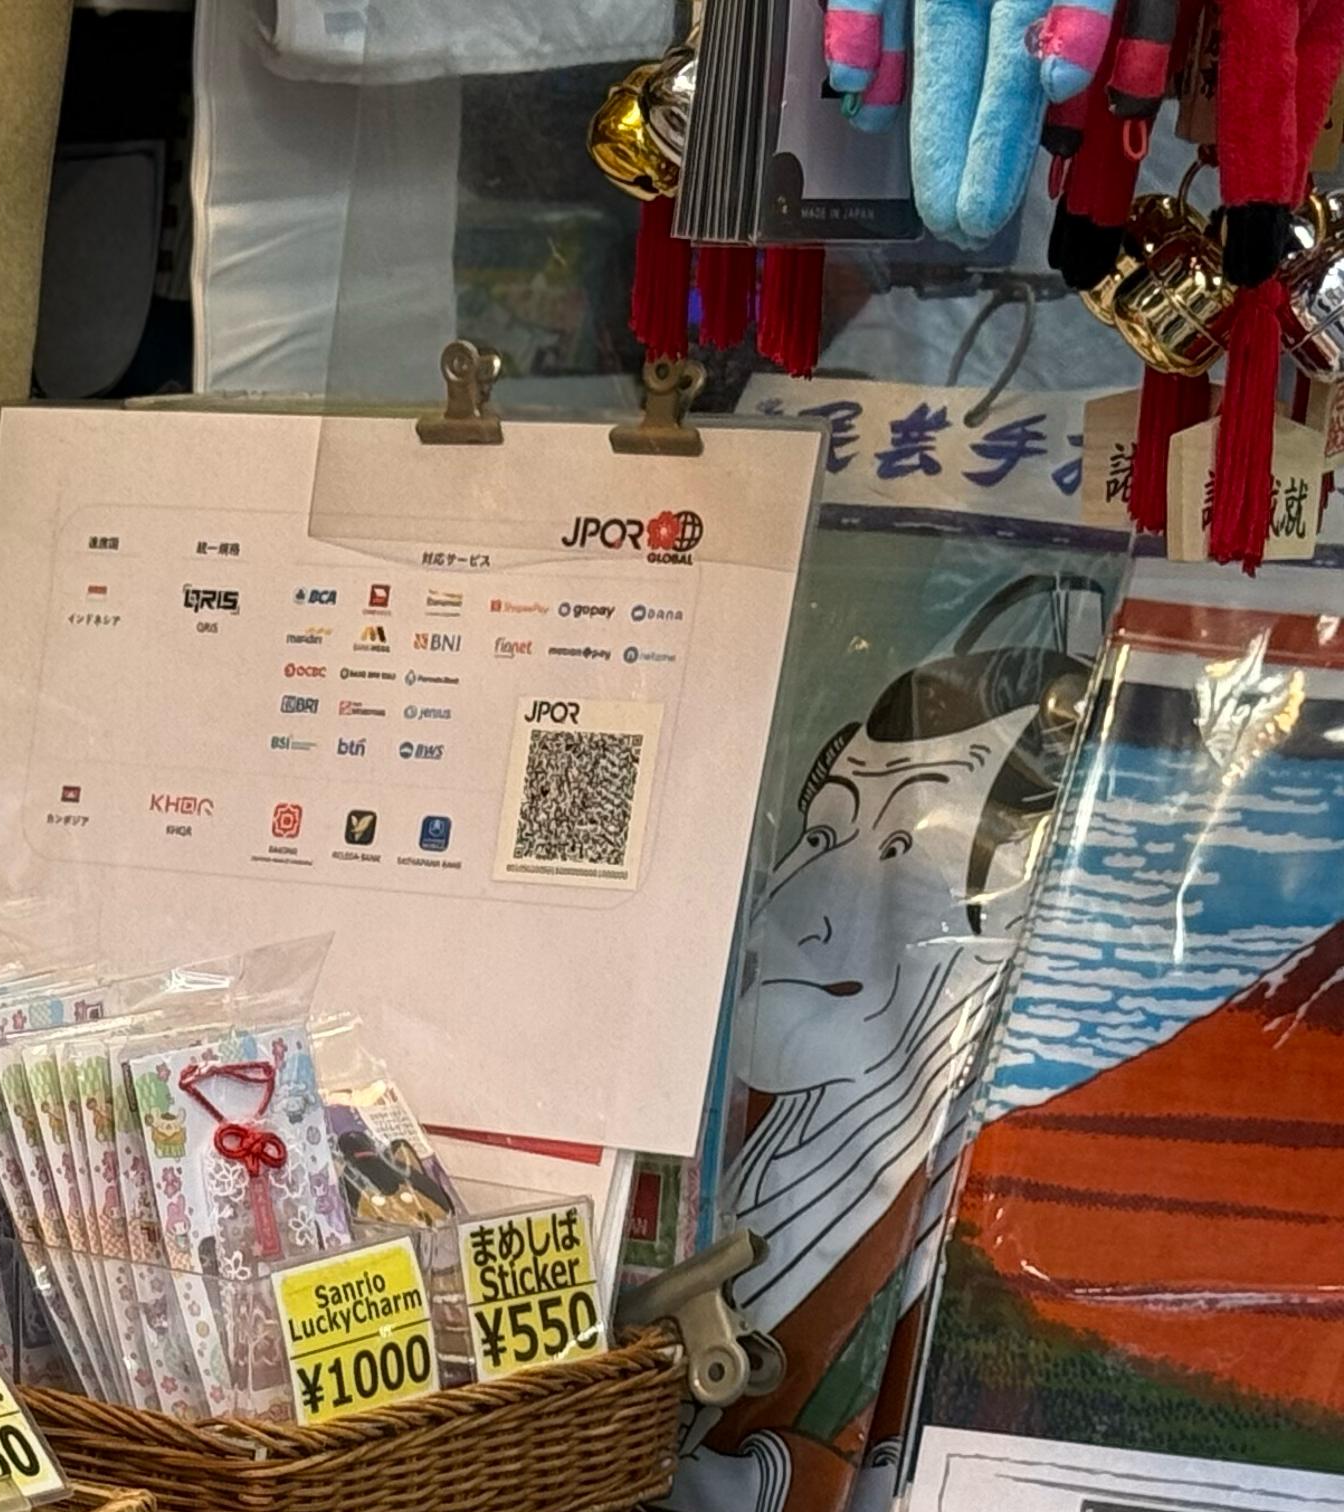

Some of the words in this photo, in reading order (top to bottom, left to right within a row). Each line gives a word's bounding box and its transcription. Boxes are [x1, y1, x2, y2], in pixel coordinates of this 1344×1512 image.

[801, 206, 829, 220] MADE
[831, 207, 842, 220] IN
[843, 207, 876, 221] JAPAN
[561, 516, 644, 551] JPQR
[646, 551, 694, 566] GLOBAL
[421, 551, 491, 568] 対応サービス
[67, 612, 121, 627] インドネシア
[572, 603, 616, 619] gopay
[429, 633, 462, 652] BNI
[524, 700, 581, 725] JPQR
[46, 813, 90, 827] カンボジア
[468, 1209, 581, 1267] まめしば
[314, 1272, 387, 1309] Sanrio
[479, 1255, 581, 1301] Sticker
[288, 1285, 423, 1342] LuckyCharm
[474, 1292, 600, 1368] ¥550
[296, 1333, 433, 1412] ¥1000
